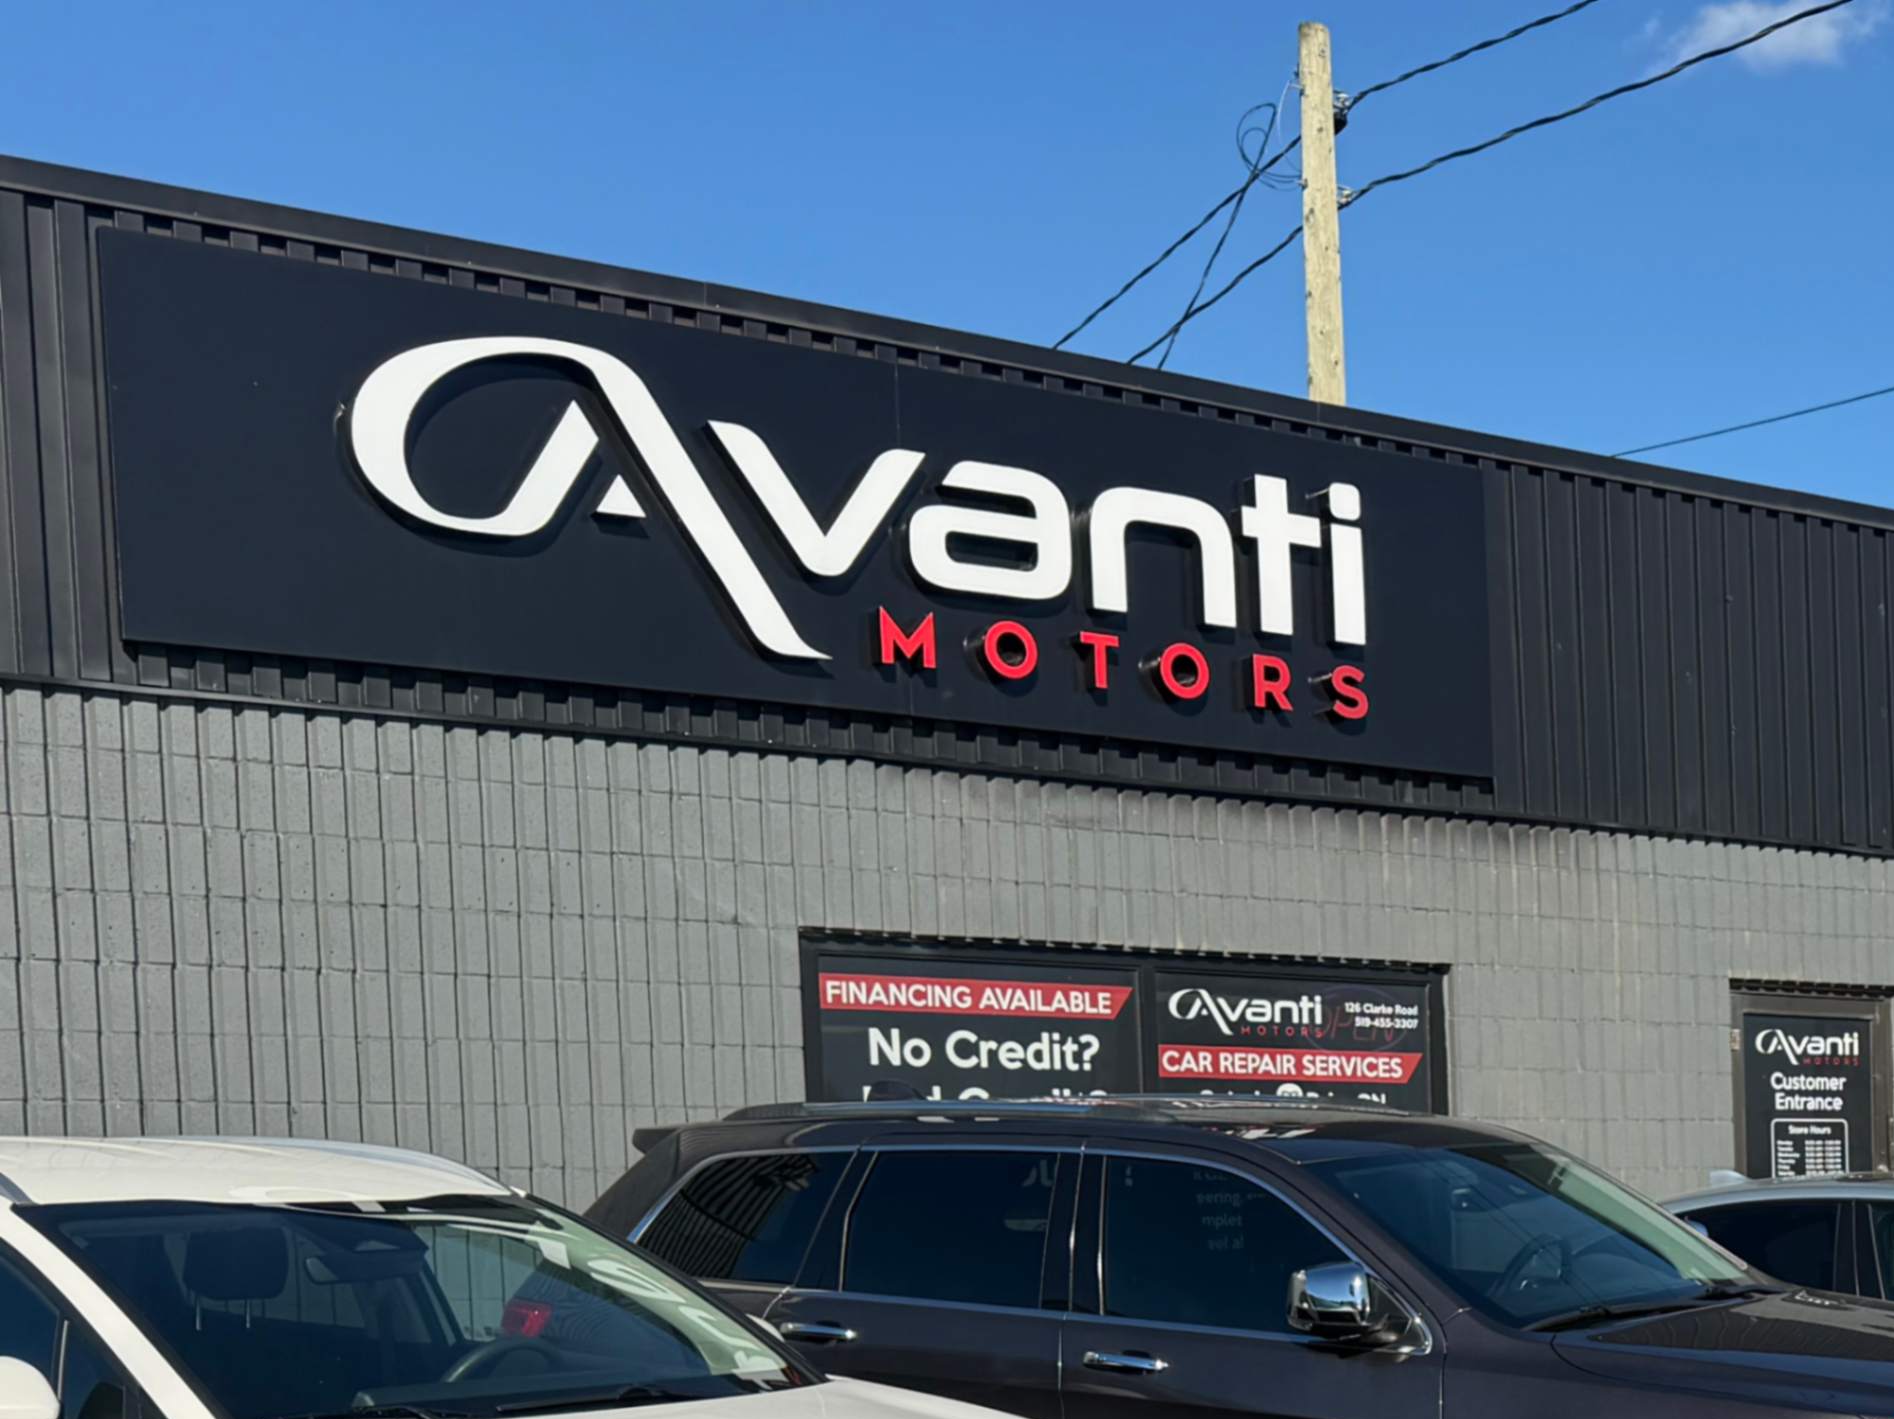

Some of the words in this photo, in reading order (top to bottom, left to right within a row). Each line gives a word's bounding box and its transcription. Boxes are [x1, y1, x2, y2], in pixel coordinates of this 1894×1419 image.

[349, 336, 1367, 660] Avanti
[877, 604, 1369, 720] MOTORS
[825, 980, 972, 1009] FINANCING
[979, 987, 1112, 1015] AVAILABLE
[1168, 988, 1323, 1036] Avanti
[1394, 1004, 1419, 1016] Road
[1240, 1024, 1325, 1039] MOTORS
[1755, 1029, 1859, 1065] Avanti
[868, 1027, 932, 1068] No
[945, 1029, 1101, 1071] Credit?
[1161, 1050, 1213, 1073] CAR
[1219, 1052, 1296, 1076] REPAIR
[1302, 1054, 1403, 1079] SERVICES
[1803, 1057, 1859, 1067] MOTORS
[1770, 1071, 1847, 1091] Customer
[1774, 1092, 1844, 1111] Entrance
